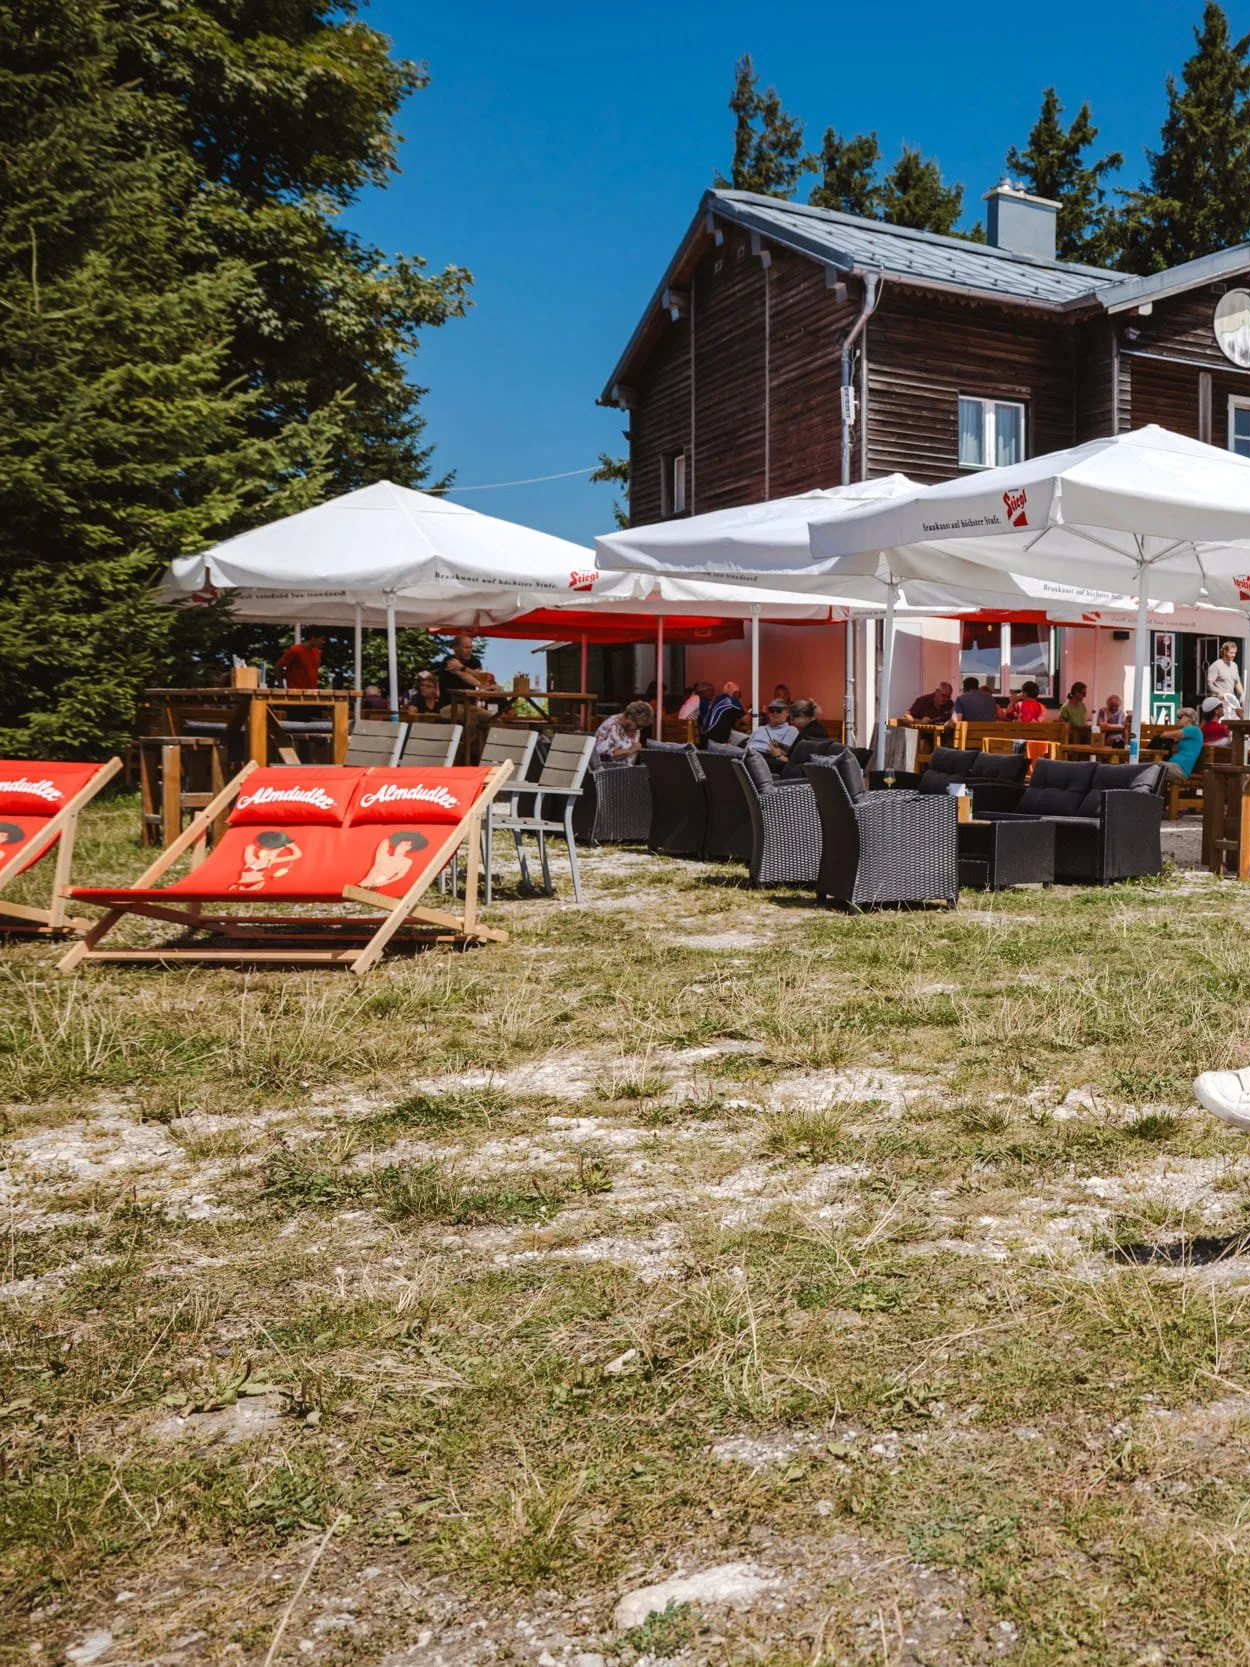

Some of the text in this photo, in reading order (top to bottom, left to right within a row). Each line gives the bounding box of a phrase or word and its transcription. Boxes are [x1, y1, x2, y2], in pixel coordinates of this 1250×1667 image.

[1003, 488, 1027, 520] Stiegl
[568, 570, 599, 588] Stiegl
[236, 785, 335, 810] Almdudler
[359, 783, 458, 809] Almdudler
